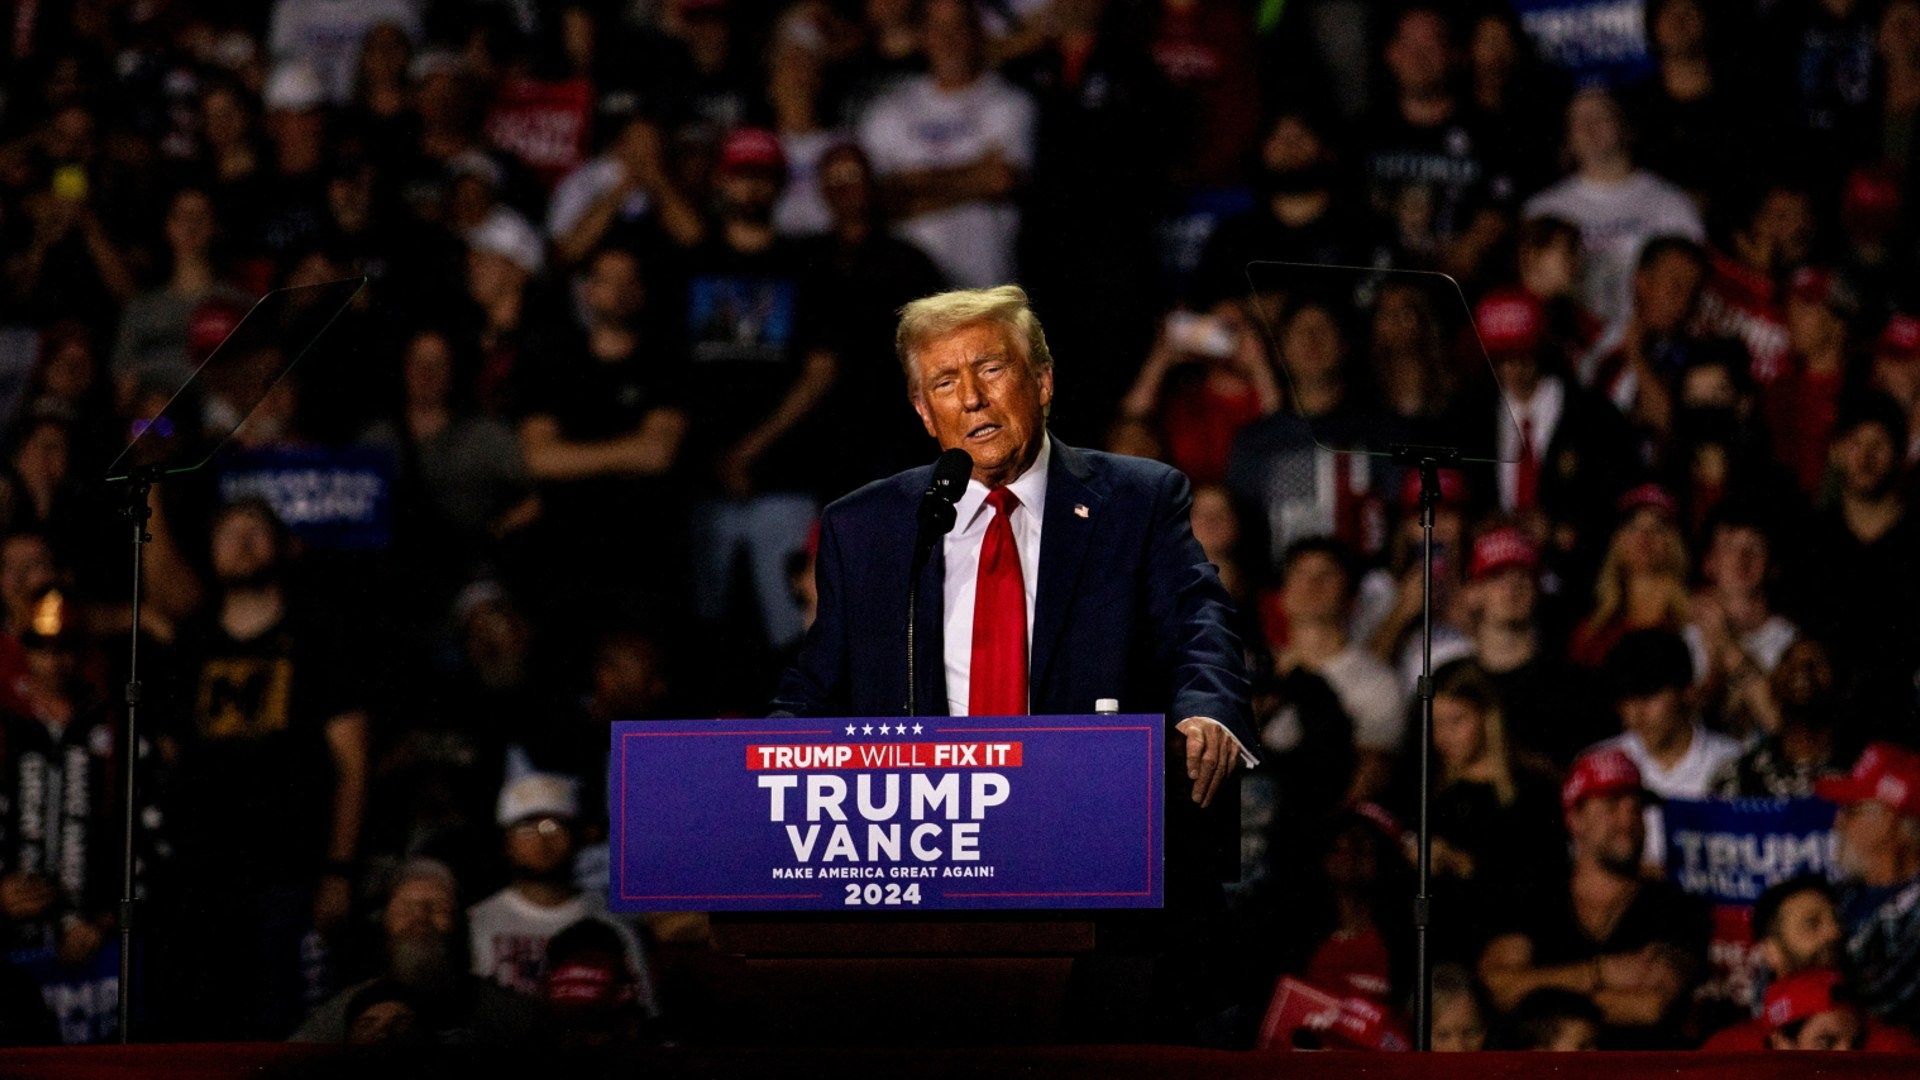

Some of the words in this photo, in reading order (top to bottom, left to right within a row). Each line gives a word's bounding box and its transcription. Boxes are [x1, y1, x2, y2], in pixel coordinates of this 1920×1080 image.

[759, 746, 853, 769] TRUMP
[860, 745, 926, 767] WILL
[935, 744, 978, 766] FIX
[986, 743, 1011, 765] IT
[758, 773, 1011, 821] TRUMP
[786, 823, 981, 862] VANCE
[773, 867, 813, 879] MAKE
[818, 867, 885, 879] AMERICA
[890, 866, 938, 878] GREAT
[943, 866, 995, 878] AGAIN!
[844, 883, 922, 905] 2024
